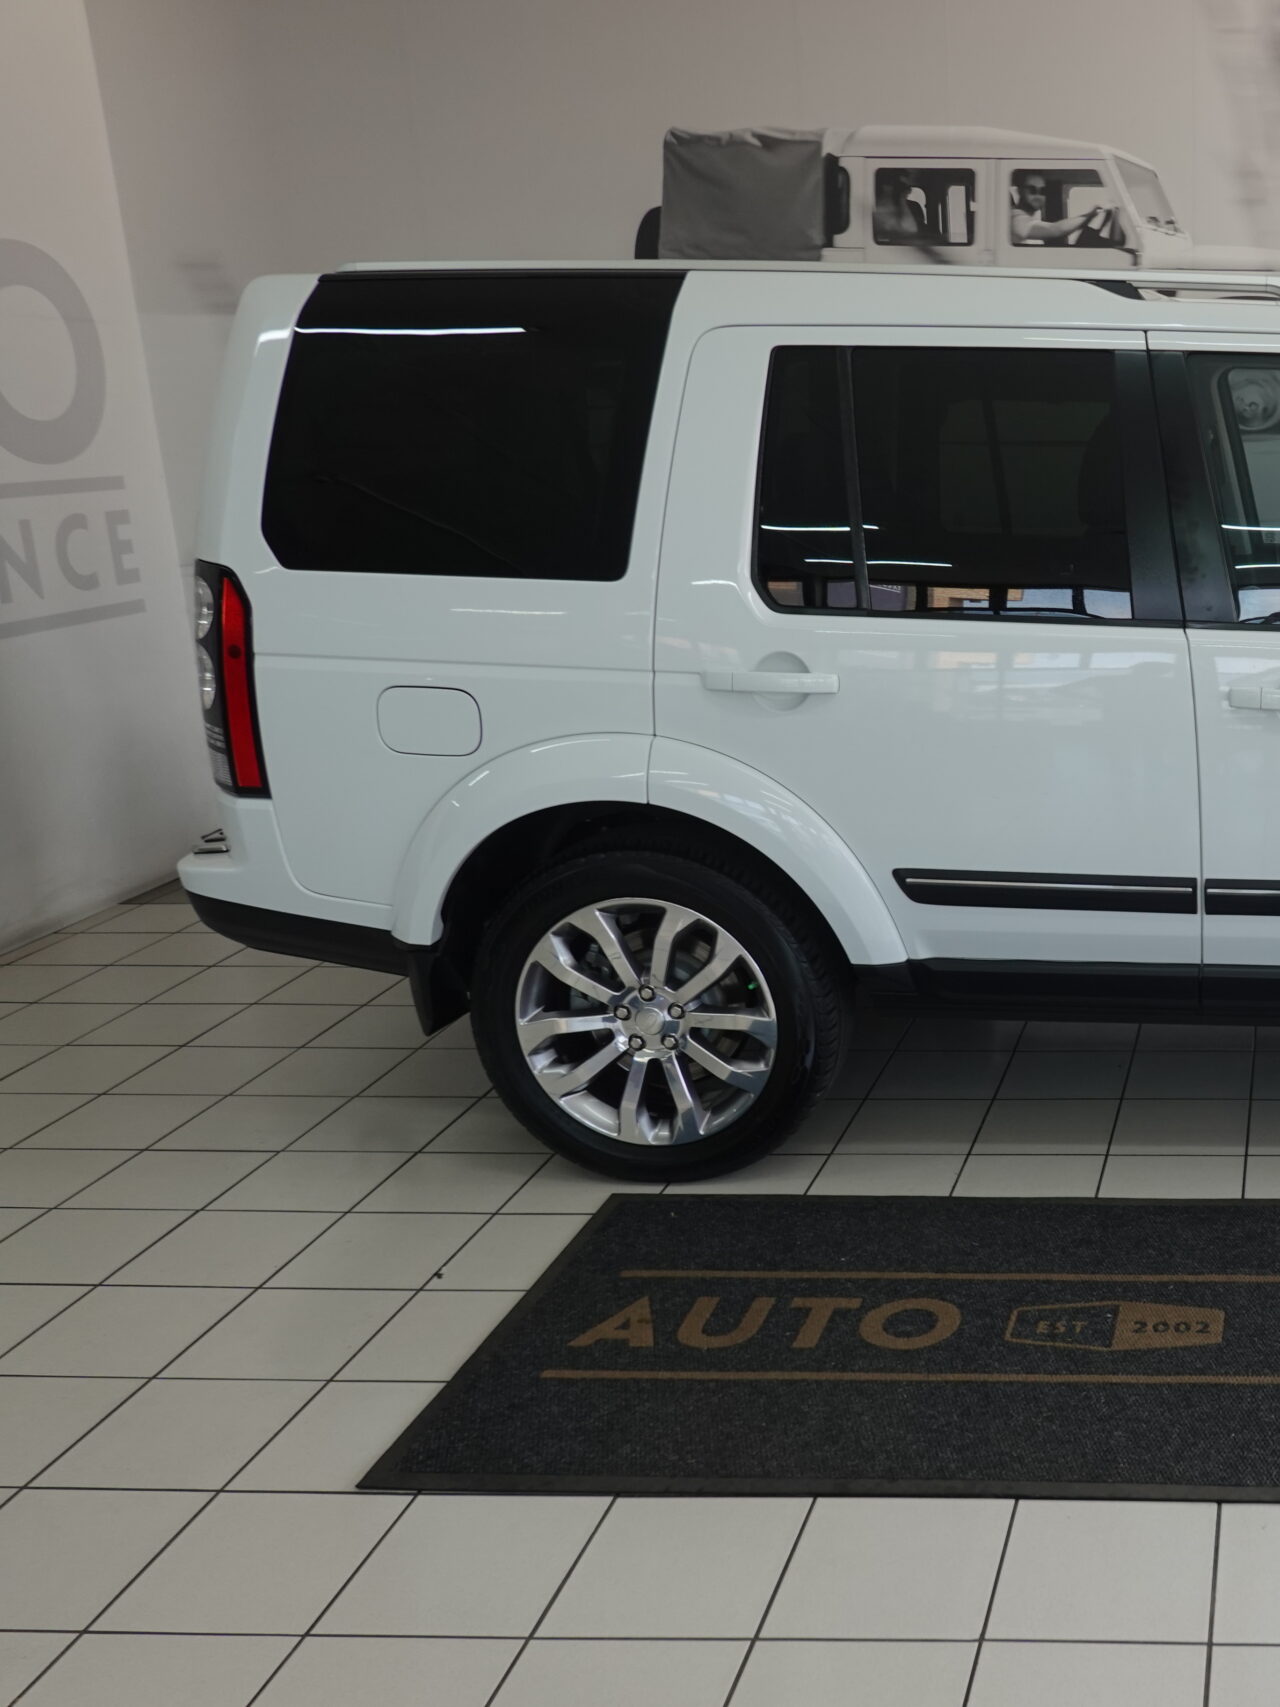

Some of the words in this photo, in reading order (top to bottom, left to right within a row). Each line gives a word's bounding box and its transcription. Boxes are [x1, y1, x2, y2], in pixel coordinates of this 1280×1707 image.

[566, 1295, 963, 1351] AUTO
[1035, 1319, 1088, 1334] EST
[1131, 1320, 1211, 1334] 2002
